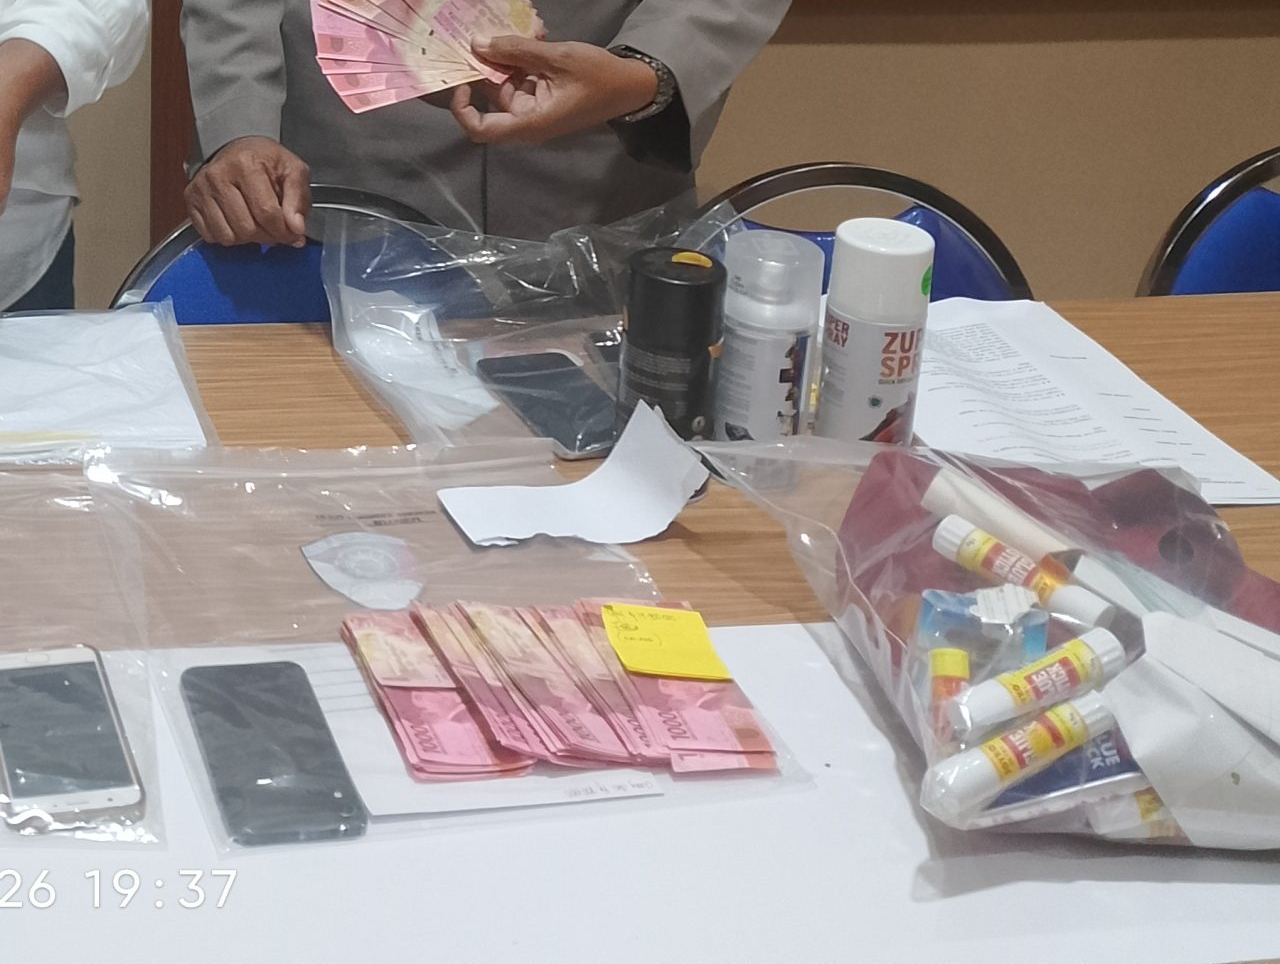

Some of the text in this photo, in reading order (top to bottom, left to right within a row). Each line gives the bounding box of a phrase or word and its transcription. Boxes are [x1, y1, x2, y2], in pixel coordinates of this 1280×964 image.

[1031, 670, 1057, 694] LUE
[1046, 662, 1071, 689] TICK
[1096, 735, 1122, 767] LUE
